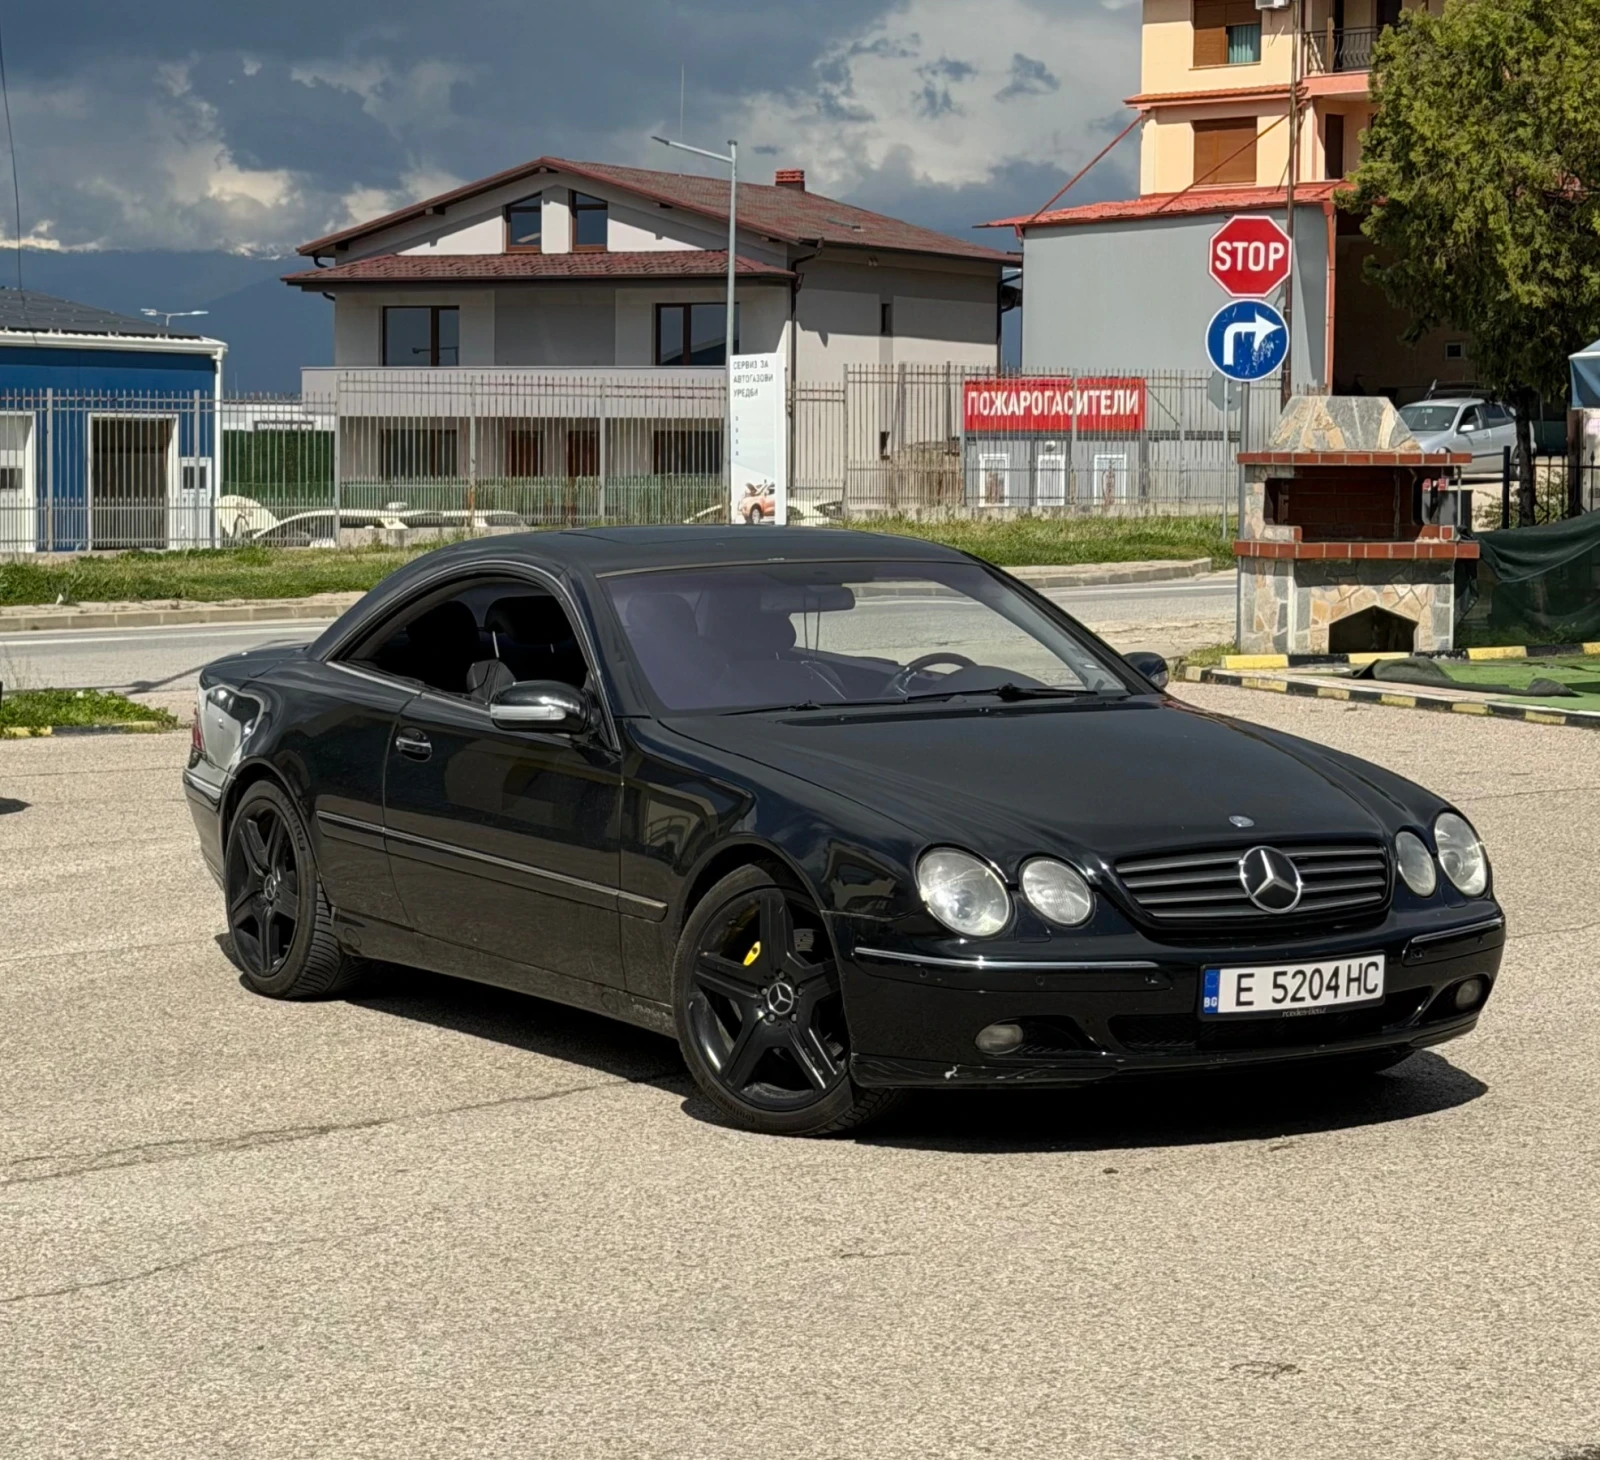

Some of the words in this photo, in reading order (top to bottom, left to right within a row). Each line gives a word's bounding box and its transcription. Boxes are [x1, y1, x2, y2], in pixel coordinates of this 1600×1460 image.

[1215, 241, 1285, 271] STOP
[733, 360, 757, 370] СЕРВИЗ
[760, 360, 769, 369] ЗА
[733, 373, 774, 383] АВТОГАЗОВИ
[733, 388, 759, 398] УРЕДБИ
[967, 389, 1139, 416] ПОЖАРОГАСИТЕЛИ
[1235, 972, 1255, 1007] E
[1204, 997, 1217, 1008] BG
